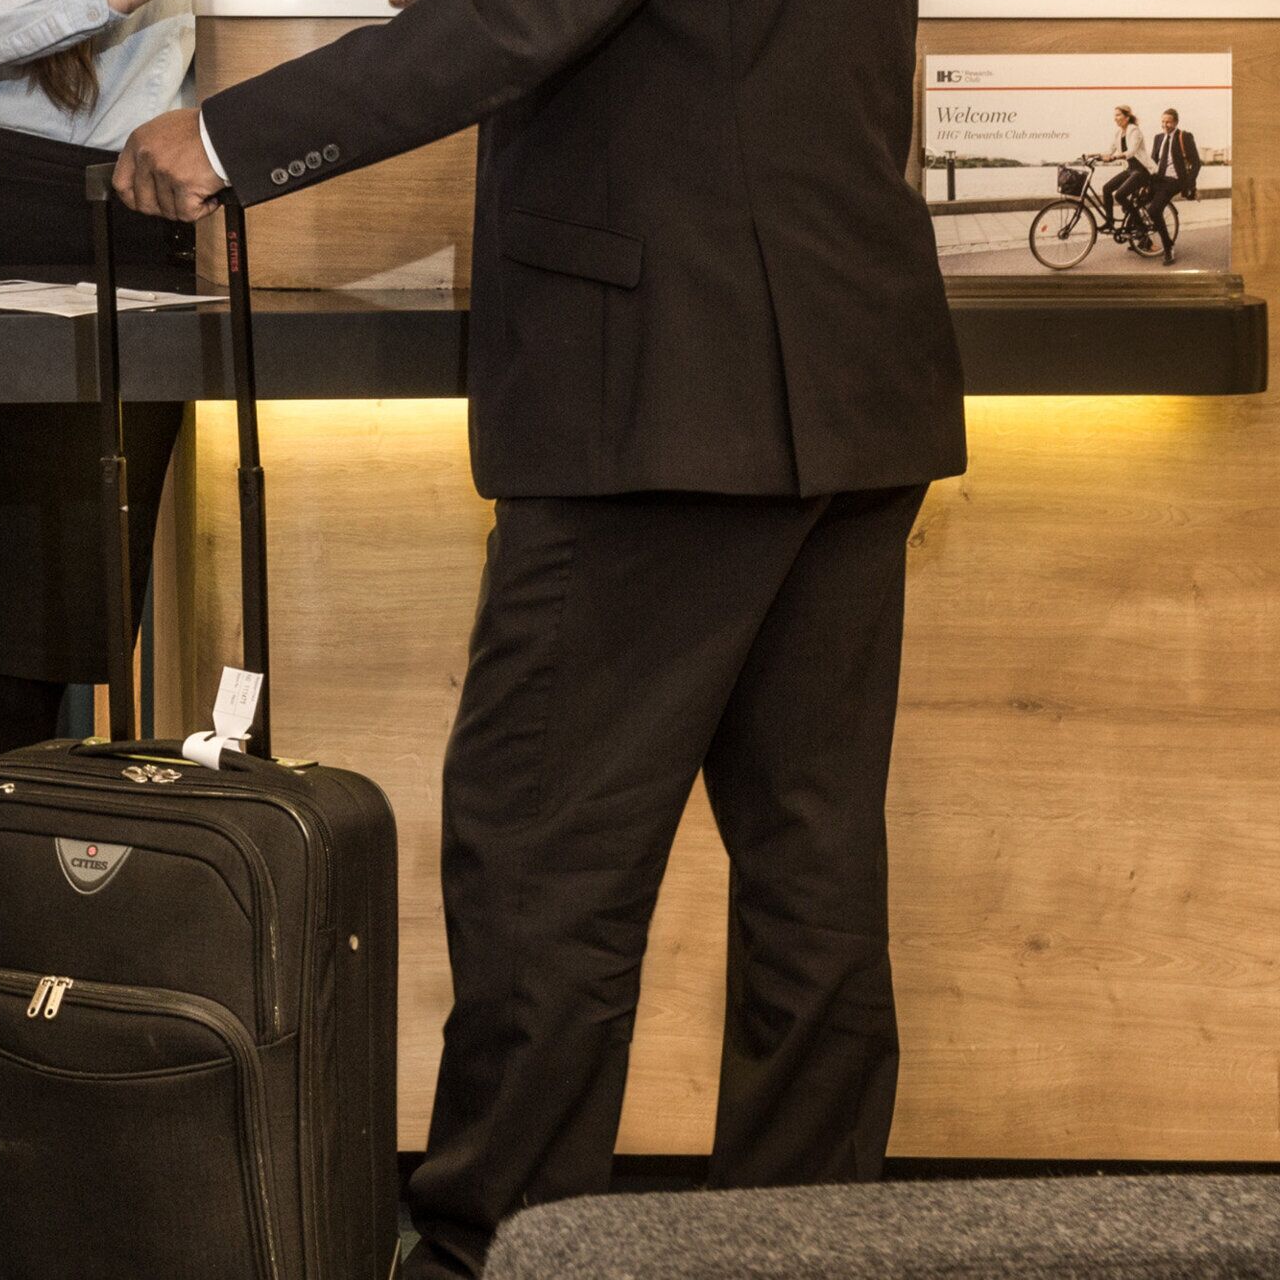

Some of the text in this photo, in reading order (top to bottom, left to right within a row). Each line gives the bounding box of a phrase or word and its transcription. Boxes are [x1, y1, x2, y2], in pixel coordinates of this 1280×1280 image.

[937, 106, 1018, 123] Welcome
[964, 130, 1002, 140] Rewards
[1005, 130, 1028, 140] Club
[1029, 130, 1070, 140] members
[71, 858, 108, 870] CITIES
